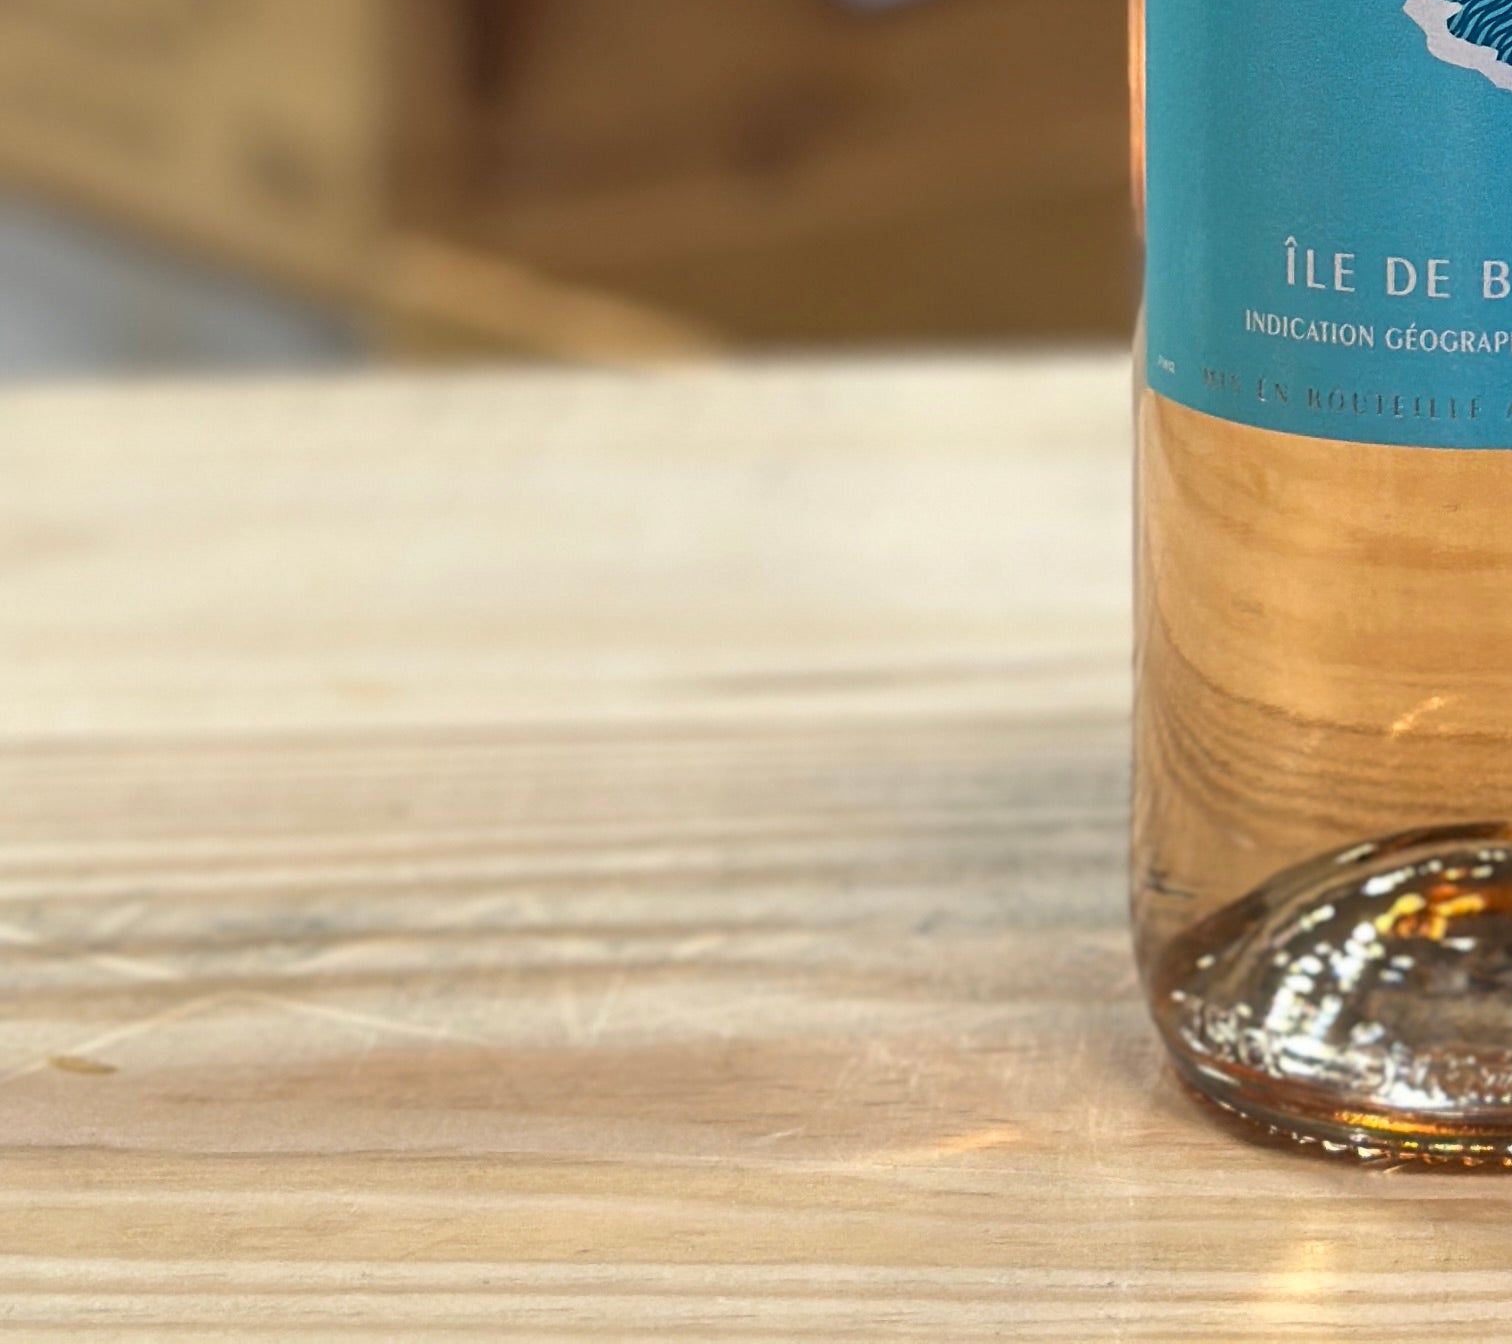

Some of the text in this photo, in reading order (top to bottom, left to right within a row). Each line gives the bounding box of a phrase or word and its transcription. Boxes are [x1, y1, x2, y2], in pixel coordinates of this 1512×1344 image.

[1284, 235, 1356, 293] ÎLE
[1386, 256, 1451, 299] DE
[1244, 308, 1375, 349] INDICATION
